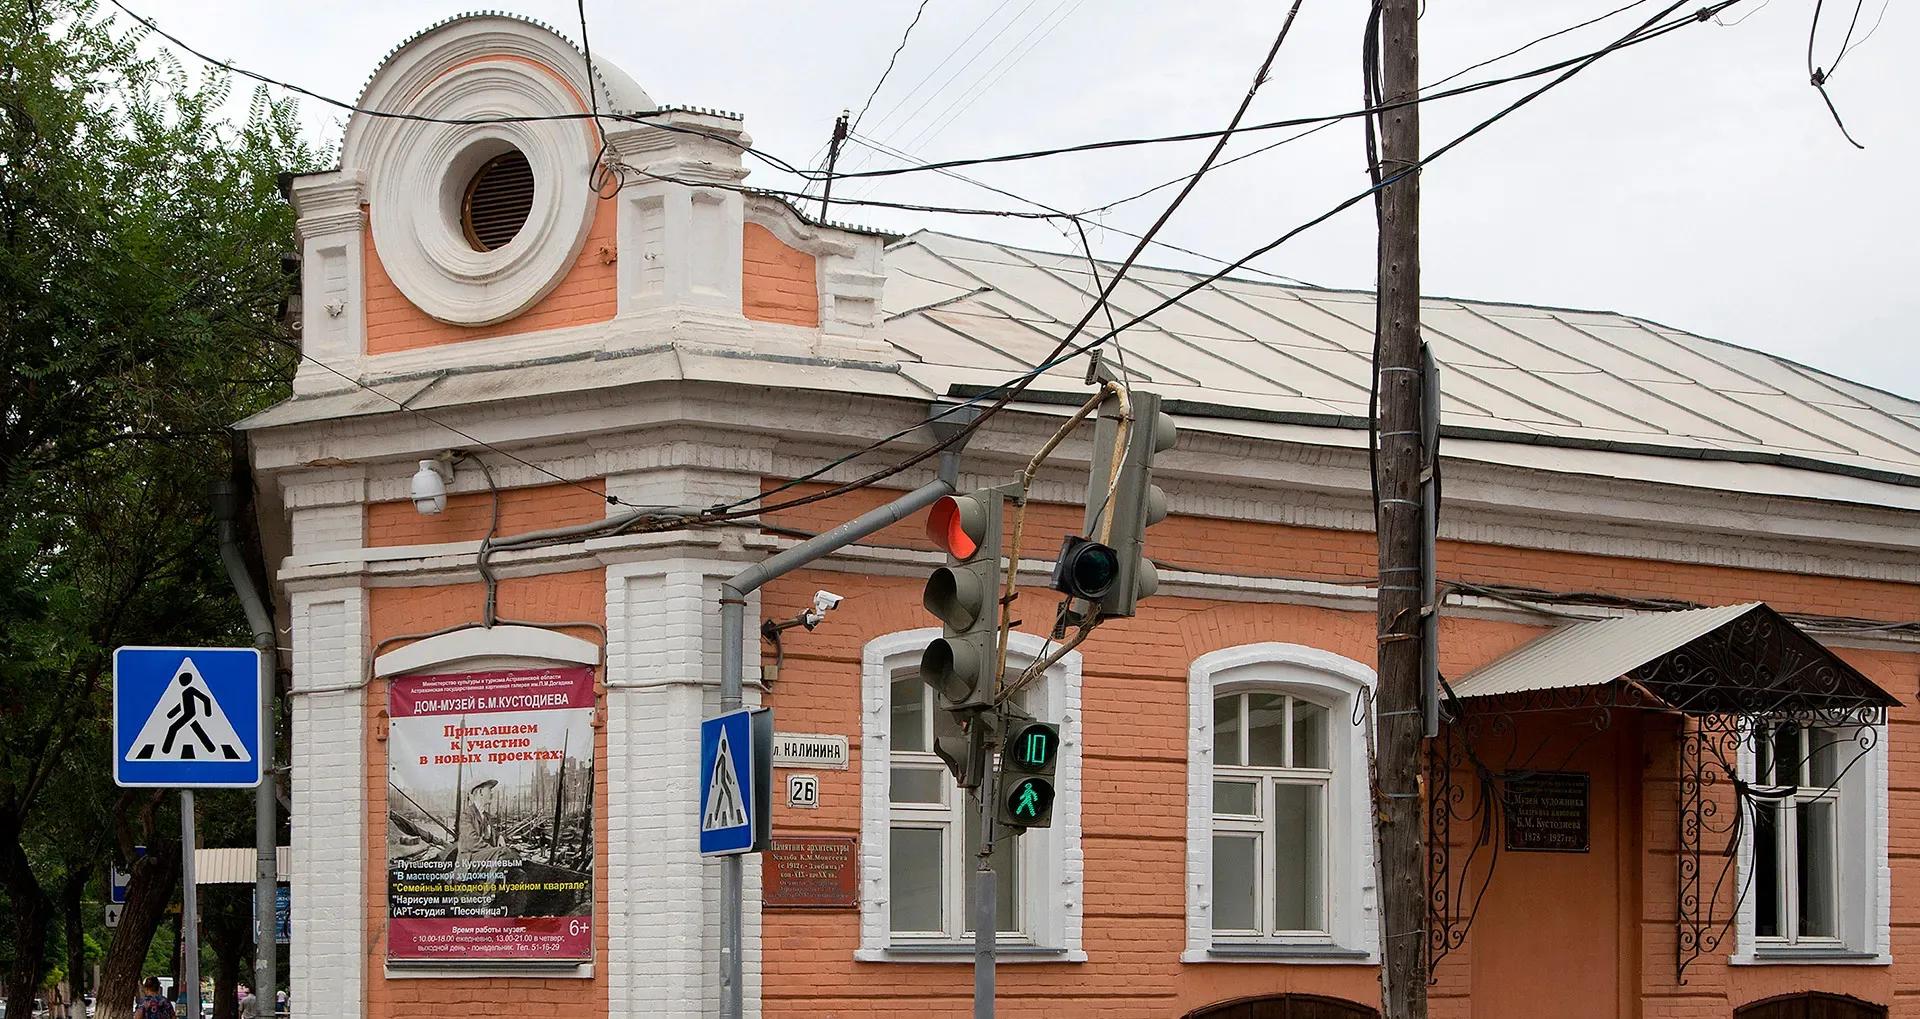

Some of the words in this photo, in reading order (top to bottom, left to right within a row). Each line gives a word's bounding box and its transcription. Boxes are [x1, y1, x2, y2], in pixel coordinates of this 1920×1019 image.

[414, 696, 474, 714] ДОМ-МУЗЕЙ
[478, 693, 569, 709] Б.М.КУСТОДИЕВА
[443, 724, 538, 738] Приглашаем
[450, 741, 461, 750] к
[466, 738, 531, 752] участию
[784, 742, 840, 758] КАЛИНИНА
[1026, 734, 1046, 764] 10
[419, 755, 428, 765] в
[434, 752, 482, 765] новых
[488, 750, 564, 764] проектах:
[792, 782, 814, 801] 26
[771, 840, 806, 851] Памятник
[806, 844, 850, 855] архитектуры
[394, 860, 452, 870] "Путешествуя
[462, 858, 527, 869] Кустодиевым"
[393, 871, 404, 880] "В
[406, 871, 454, 881] мастерской
[456, 870, 508, 881] художника"
[392, 882, 442, 892] "Семейный
[444, 882, 489, 892] выходной
[498, 882, 540, 893] музейном
[544, 880, 588, 892] квартале"
[392, 895, 440, 906] "Нарисуем
[442, 896, 459, 905] мир
[460, 894, 496, 904] вместе"
[393, 906, 446, 918] (АРТ-студия
[450, 906, 508, 917] "Песочница")
[452, 926, 474, 935] Время
[475, 926, 502, 935] работы
[569, 918, 590, 936] 6+
